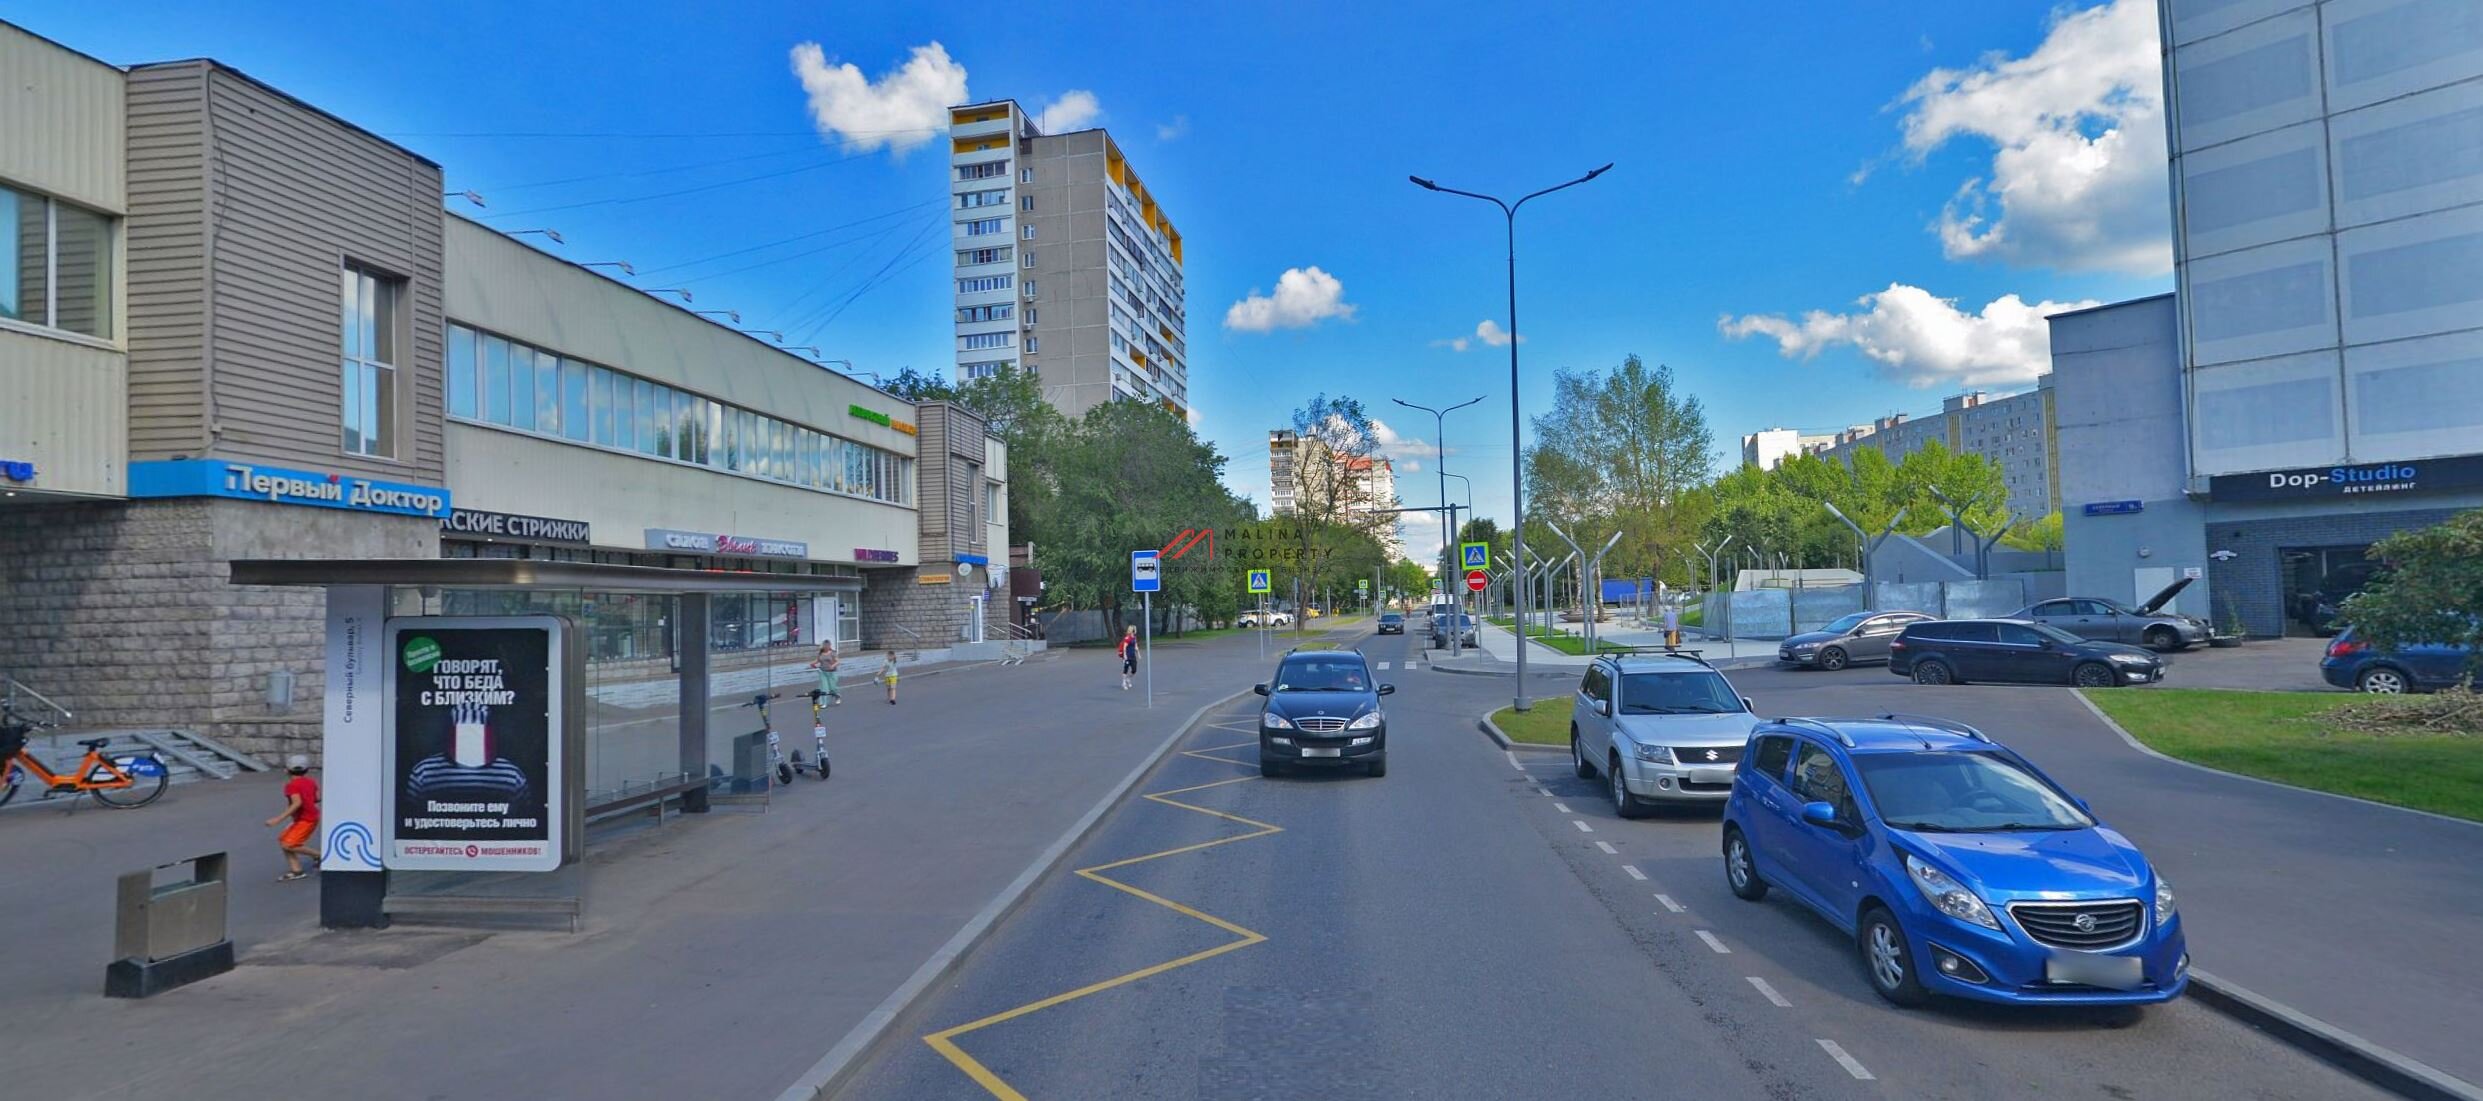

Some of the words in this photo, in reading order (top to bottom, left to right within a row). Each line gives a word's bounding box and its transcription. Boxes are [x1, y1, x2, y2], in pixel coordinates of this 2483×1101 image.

[2270, 465, 2416, 488] Dop-Studio
[224, 465, 342, 500] Первый
[349, 480, 442, 516] Доктор
[507, 516, 590, 541] СТРИЖКИ
[433, 660, 503, 675] ГОВОРЯТ,
[433, 676, 461, 690] ЧТО
[465, 676, 504, 692] БЕДА
[344, 671, 357, 723] Северный
[421, 692, 432, 706] С
[435, 691, 515, 705] БЛИЗКИМ?
[427, 801, 485, 813] Позвоните
[487, 802, 509, 815] ему
[405, 818, 412, 828] и
[414, 818, 500, 831] удостоверьтесь
[502, 818, 537, 828] лично
[404, 846, 464, 856] ОСТЕРЕГАЙТЕСЬ
